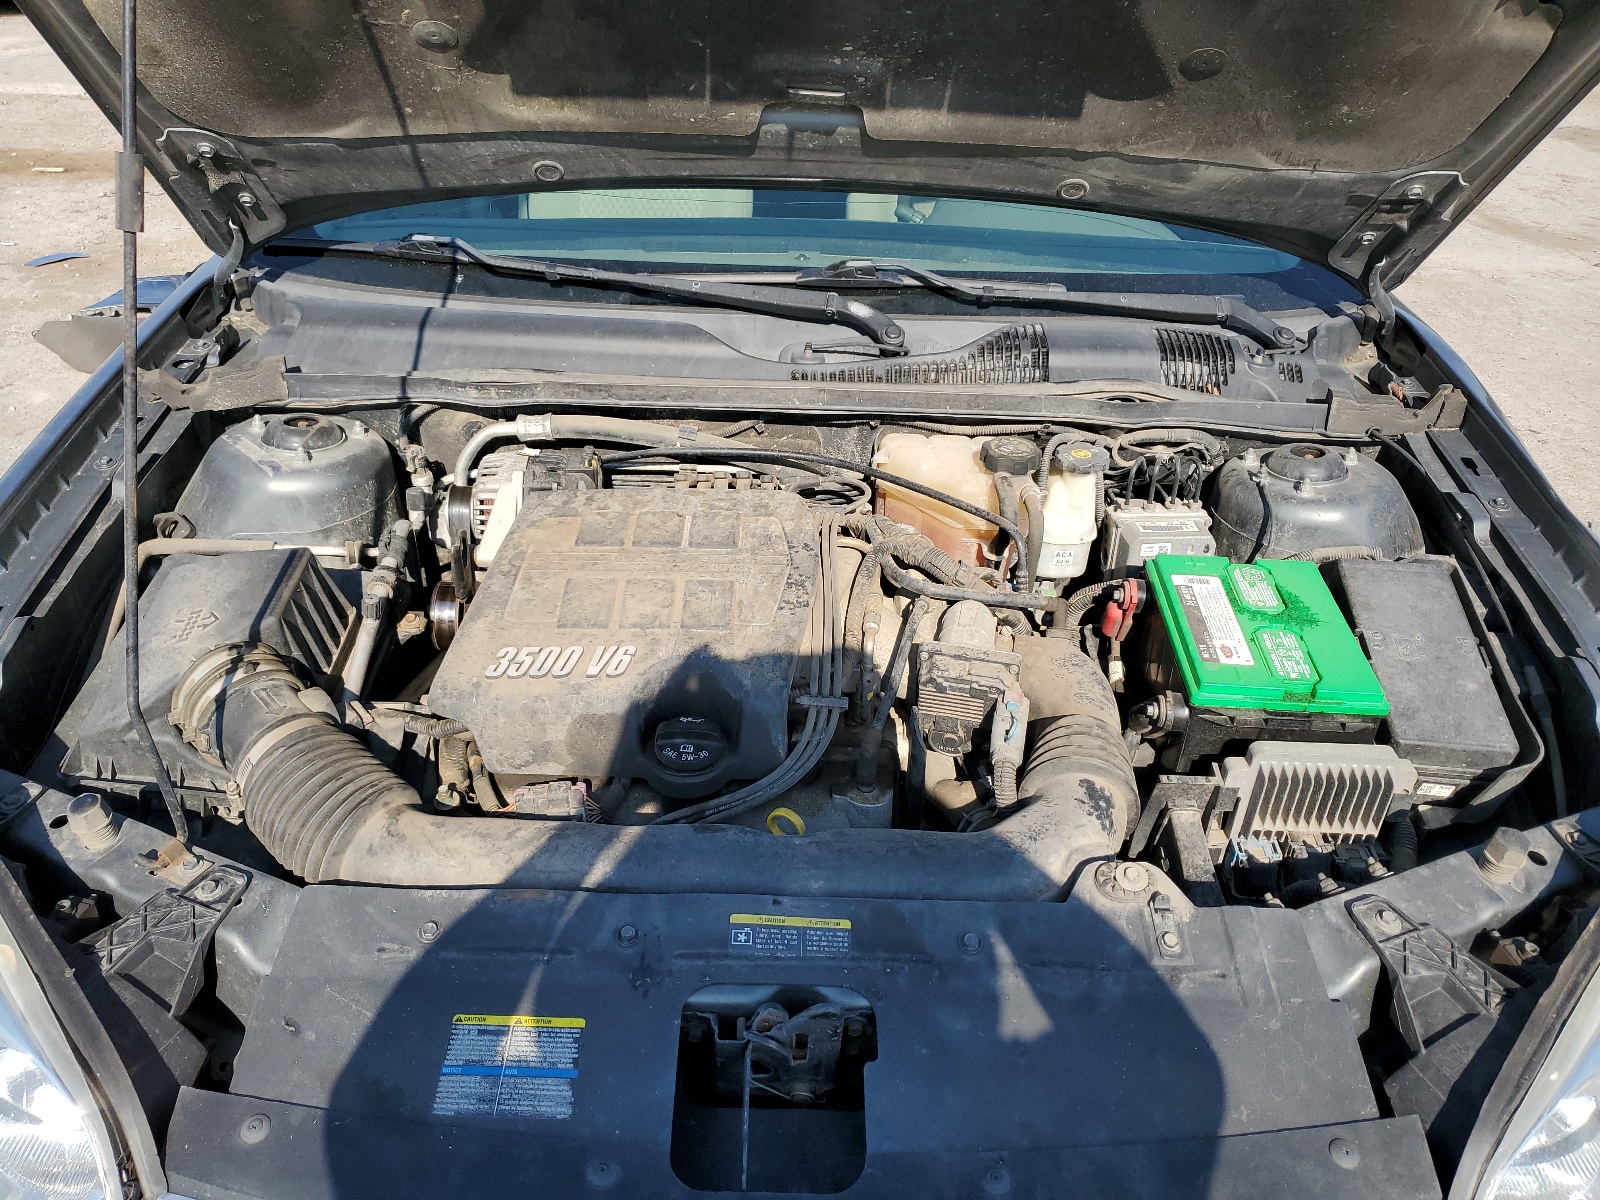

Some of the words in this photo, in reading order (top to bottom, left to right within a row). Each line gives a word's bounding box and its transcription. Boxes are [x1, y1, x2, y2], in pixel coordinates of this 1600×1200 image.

[485, 645, 584, 680] 3500
[585, 645, 637, 679] V6
[662, 747, 678, 759] SAE
[681, 749, 709, 761] 5W-30
